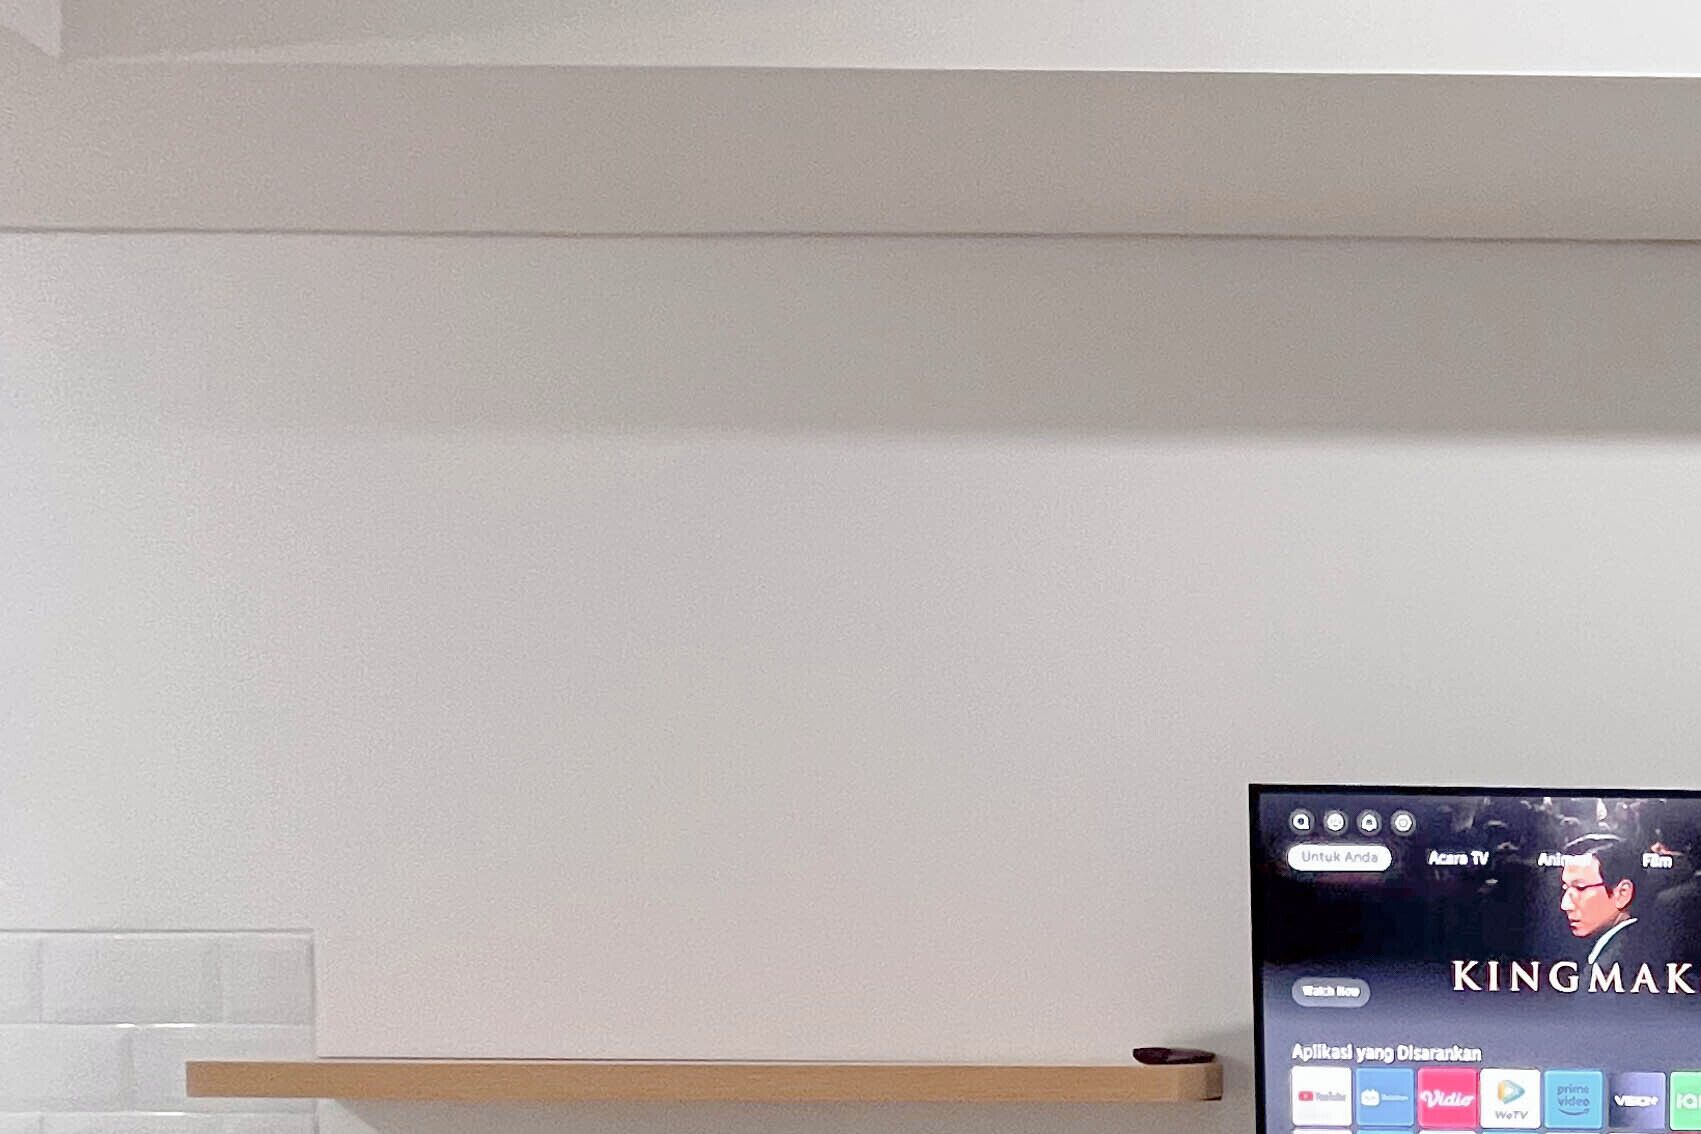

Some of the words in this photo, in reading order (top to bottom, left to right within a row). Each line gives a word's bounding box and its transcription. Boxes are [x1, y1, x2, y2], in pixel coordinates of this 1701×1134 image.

[1302, 850, 1340, 862] Untuk
[1344, 852, 1379, 863] Anda
[1428, 850, 1468, 865] Acara
[1471, 851, 1490, 865] TV
[1537, 852, 1593, 867] Anim
[1642, 853, 1673, 868] Film
[1291, 1043, 1353, 1062] Aplikasi
[1356, 1047, 1395, 1063] yang
[1397, 1045, 1482, 1062] Disarankan
[1557, 1084, 1590, 1095] prime
[1420, 1089, 1475, 1109] Vidio
[1558, 1095, 1590, 1107] video
[1495, 1111, 1528, 1119] WeTV
